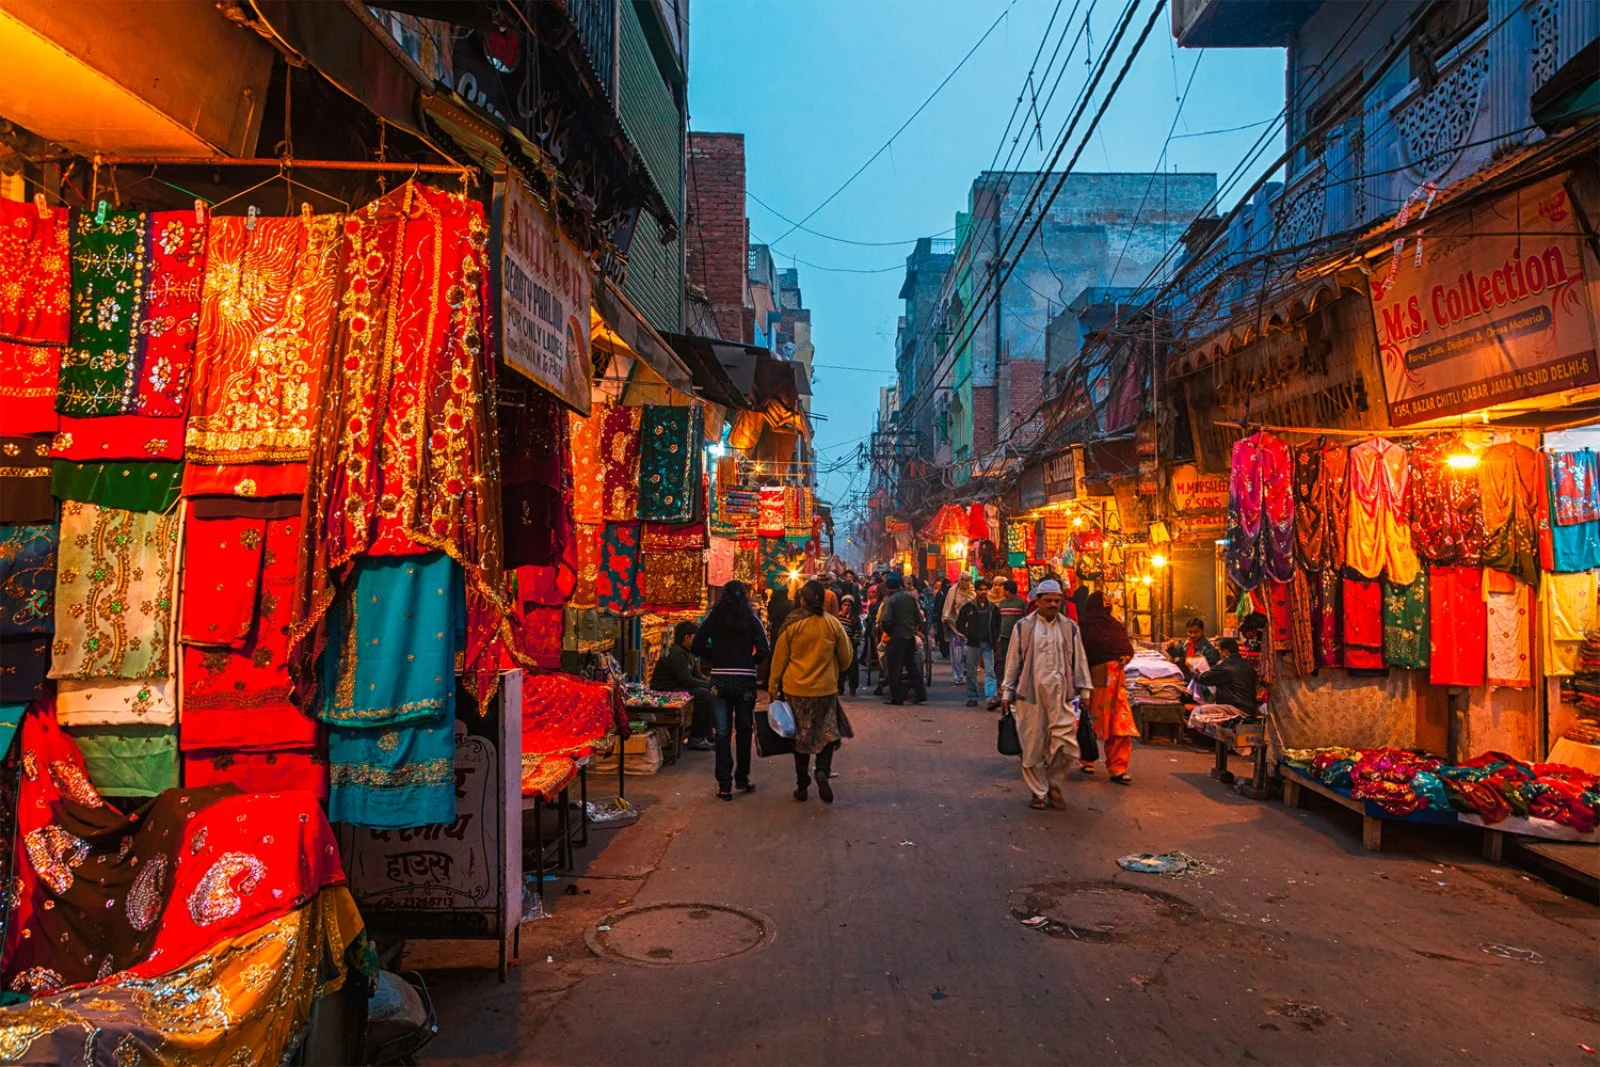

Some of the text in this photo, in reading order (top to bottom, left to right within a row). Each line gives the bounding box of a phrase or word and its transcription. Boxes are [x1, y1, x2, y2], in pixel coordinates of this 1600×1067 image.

[504, 254, 532, 312] BEAUTY
[1382, 246, 1569, 344] M.S. Collection
[507, 302, 521, 329] FOR
[522, 316, 543, 347] ONLY
[1510, 310, 1544, 332] Material
[1412, 394, 1436, 415] BAZAR
[1437, 390, 1460, 410] CHITLI
[1461, 384, 1489, 404] QABAR
[1490, 380, 1514, 398] JAMA
[1515, 371, 1549, 393] MASJID
[1550, 358, 1589, 382] DELHI-6
[1195, 496, 1222, 509] SONS
